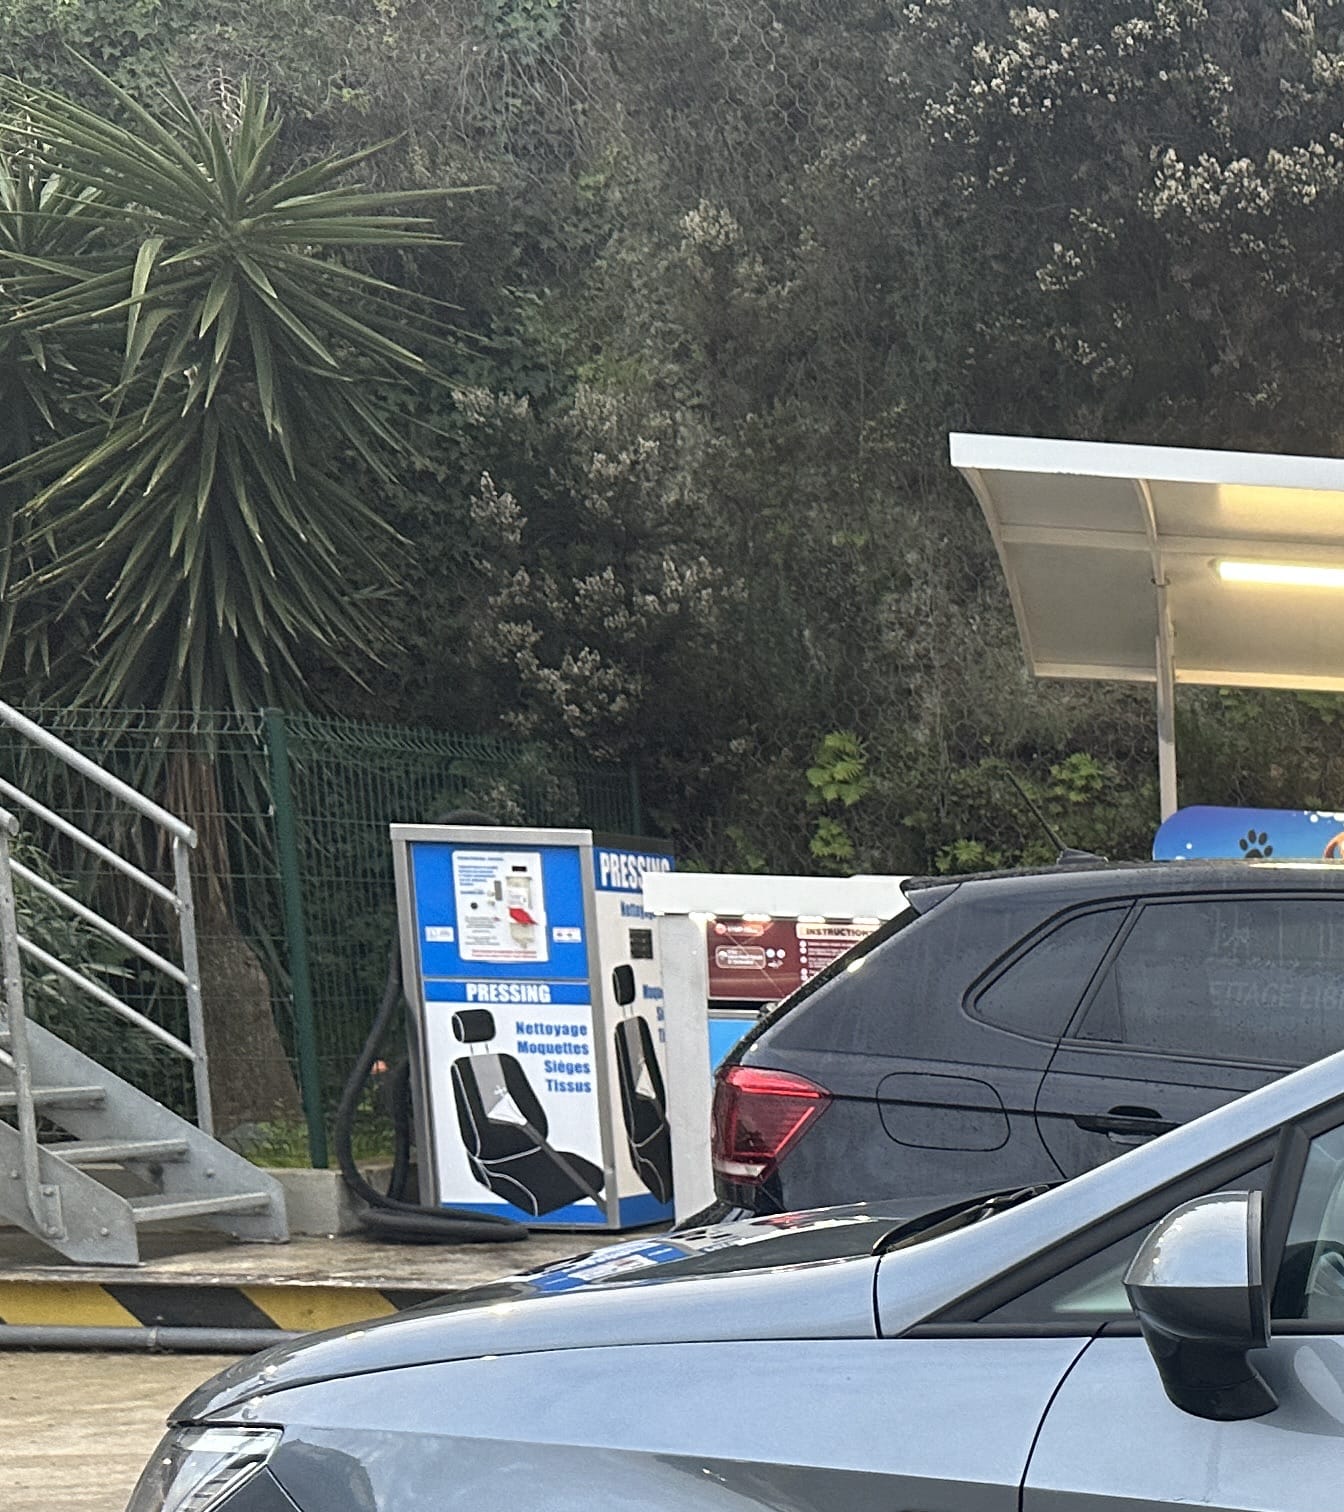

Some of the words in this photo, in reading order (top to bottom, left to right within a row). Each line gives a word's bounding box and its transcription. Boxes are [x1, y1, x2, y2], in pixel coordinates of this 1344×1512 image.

[806, 927, 873, 937] INSTRUCTION
[465, 983, 551, 1003] PRESSING
[515, 1021, 588, 1037] Nettoyage
[517, 1040, 589, 1056] Moquettes
[544, 1059, 591, 1075] Sièges
[545, 1078, 592, 1093] Tissus
